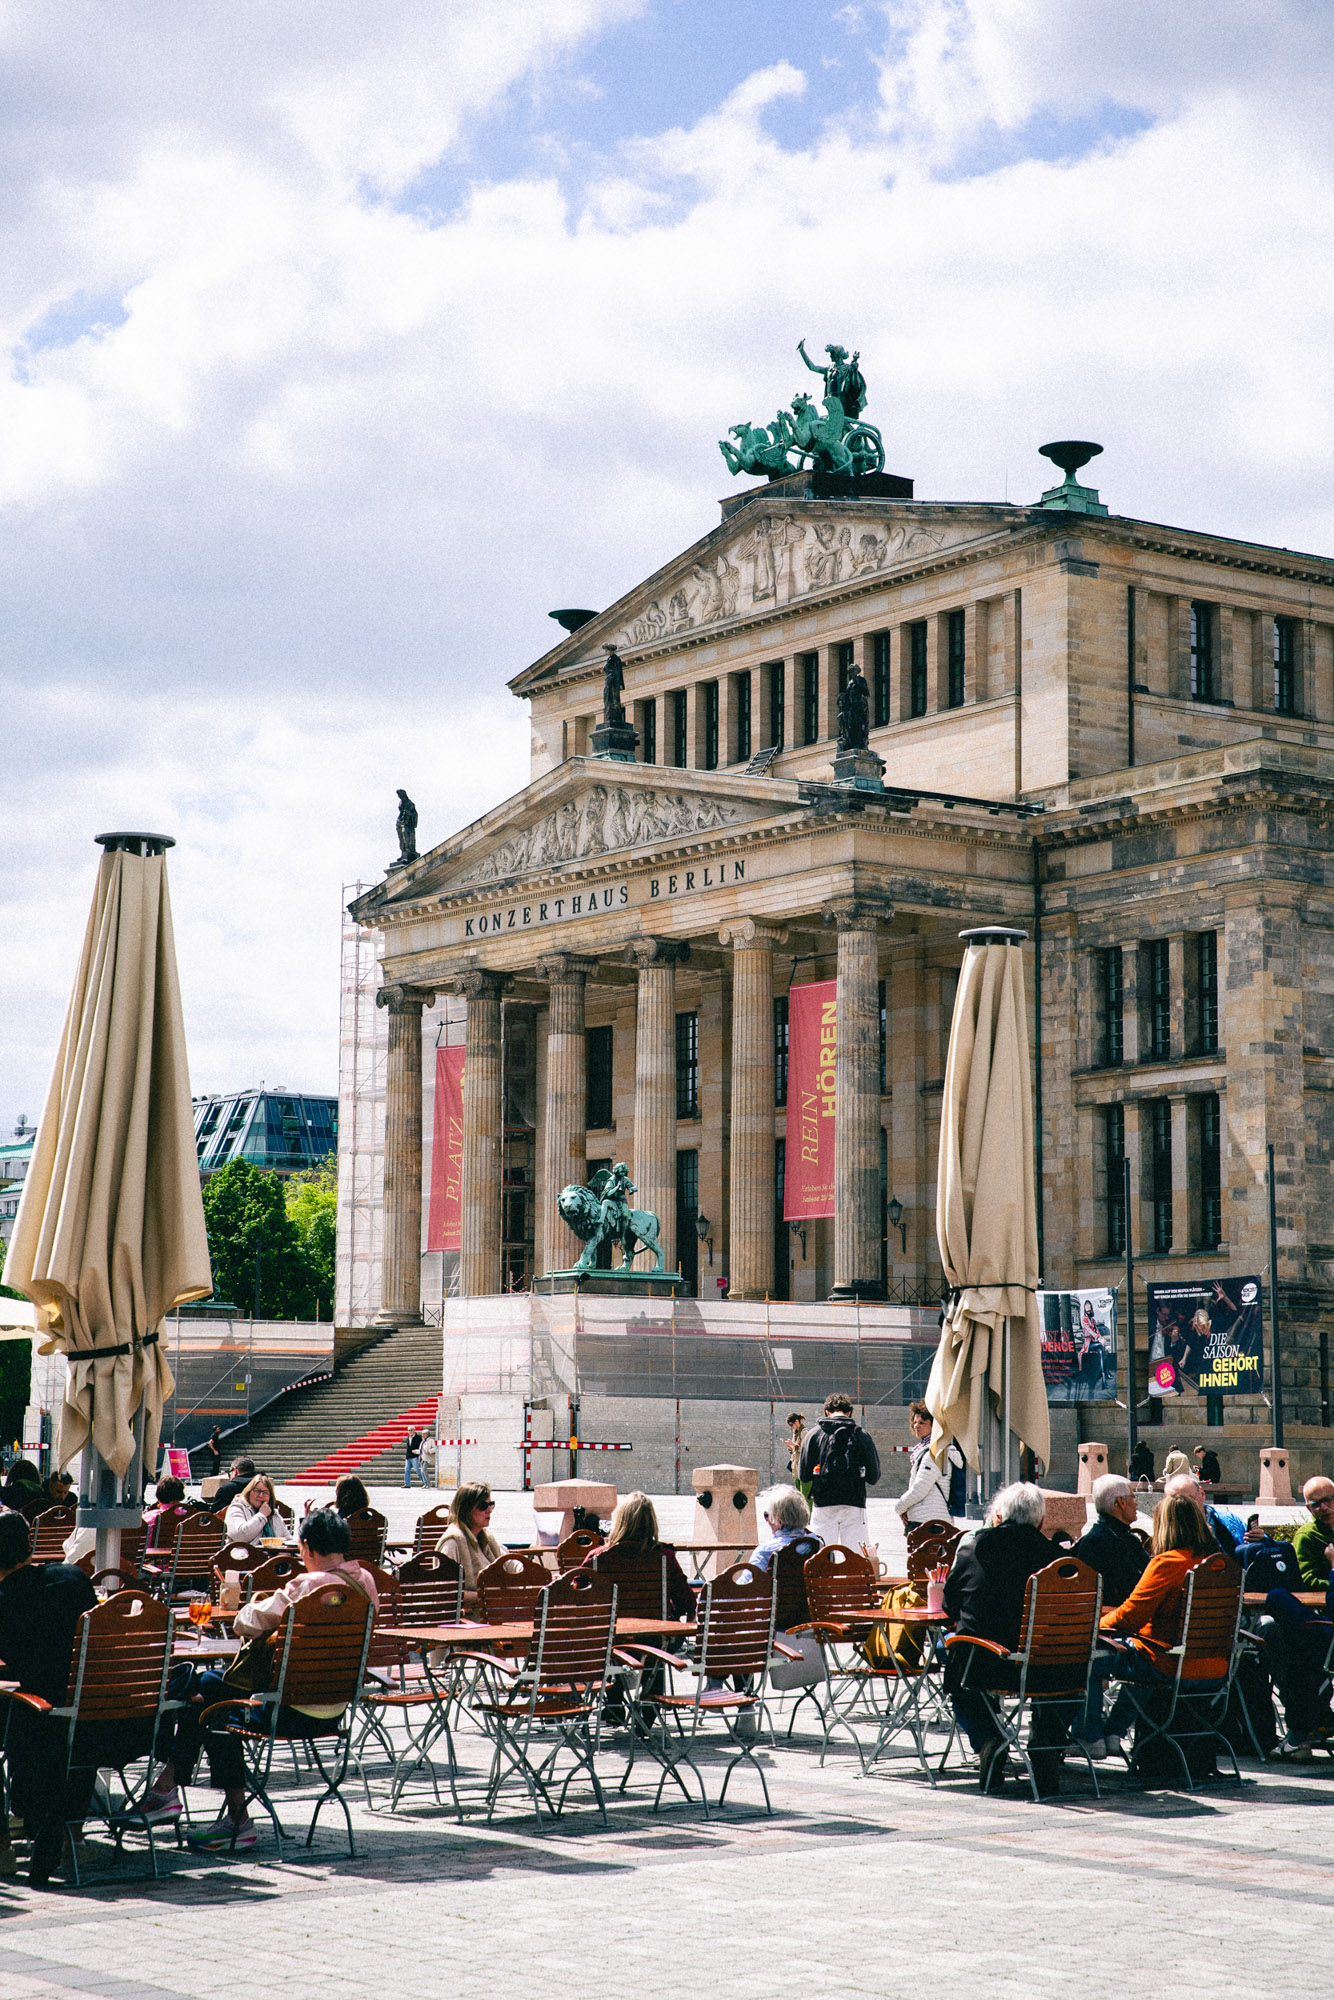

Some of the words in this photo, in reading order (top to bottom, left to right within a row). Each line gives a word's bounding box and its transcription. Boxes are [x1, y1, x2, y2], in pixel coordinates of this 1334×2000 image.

[465, 885, 628, 937] KONZERTHAUS
[650, 860, 746, 898] BERLIN
[816, 1001, 837, 1118] HÖREN
[801, 1089, 818, 1166] REIN
[445, 1116, 463, 1202] PLATZ
[1040, 1330, 1058, 1341] TIST
[1060, 1330, 1070, 1341] IN
[1209, 1333, 1227, 1346] DIE
[1203, 1345, 1239, 1359] SAISON
[1213, 1353, 1258, 1371] GEHÖRT
[1200, 1372, 1238, 1388] IHNEN
